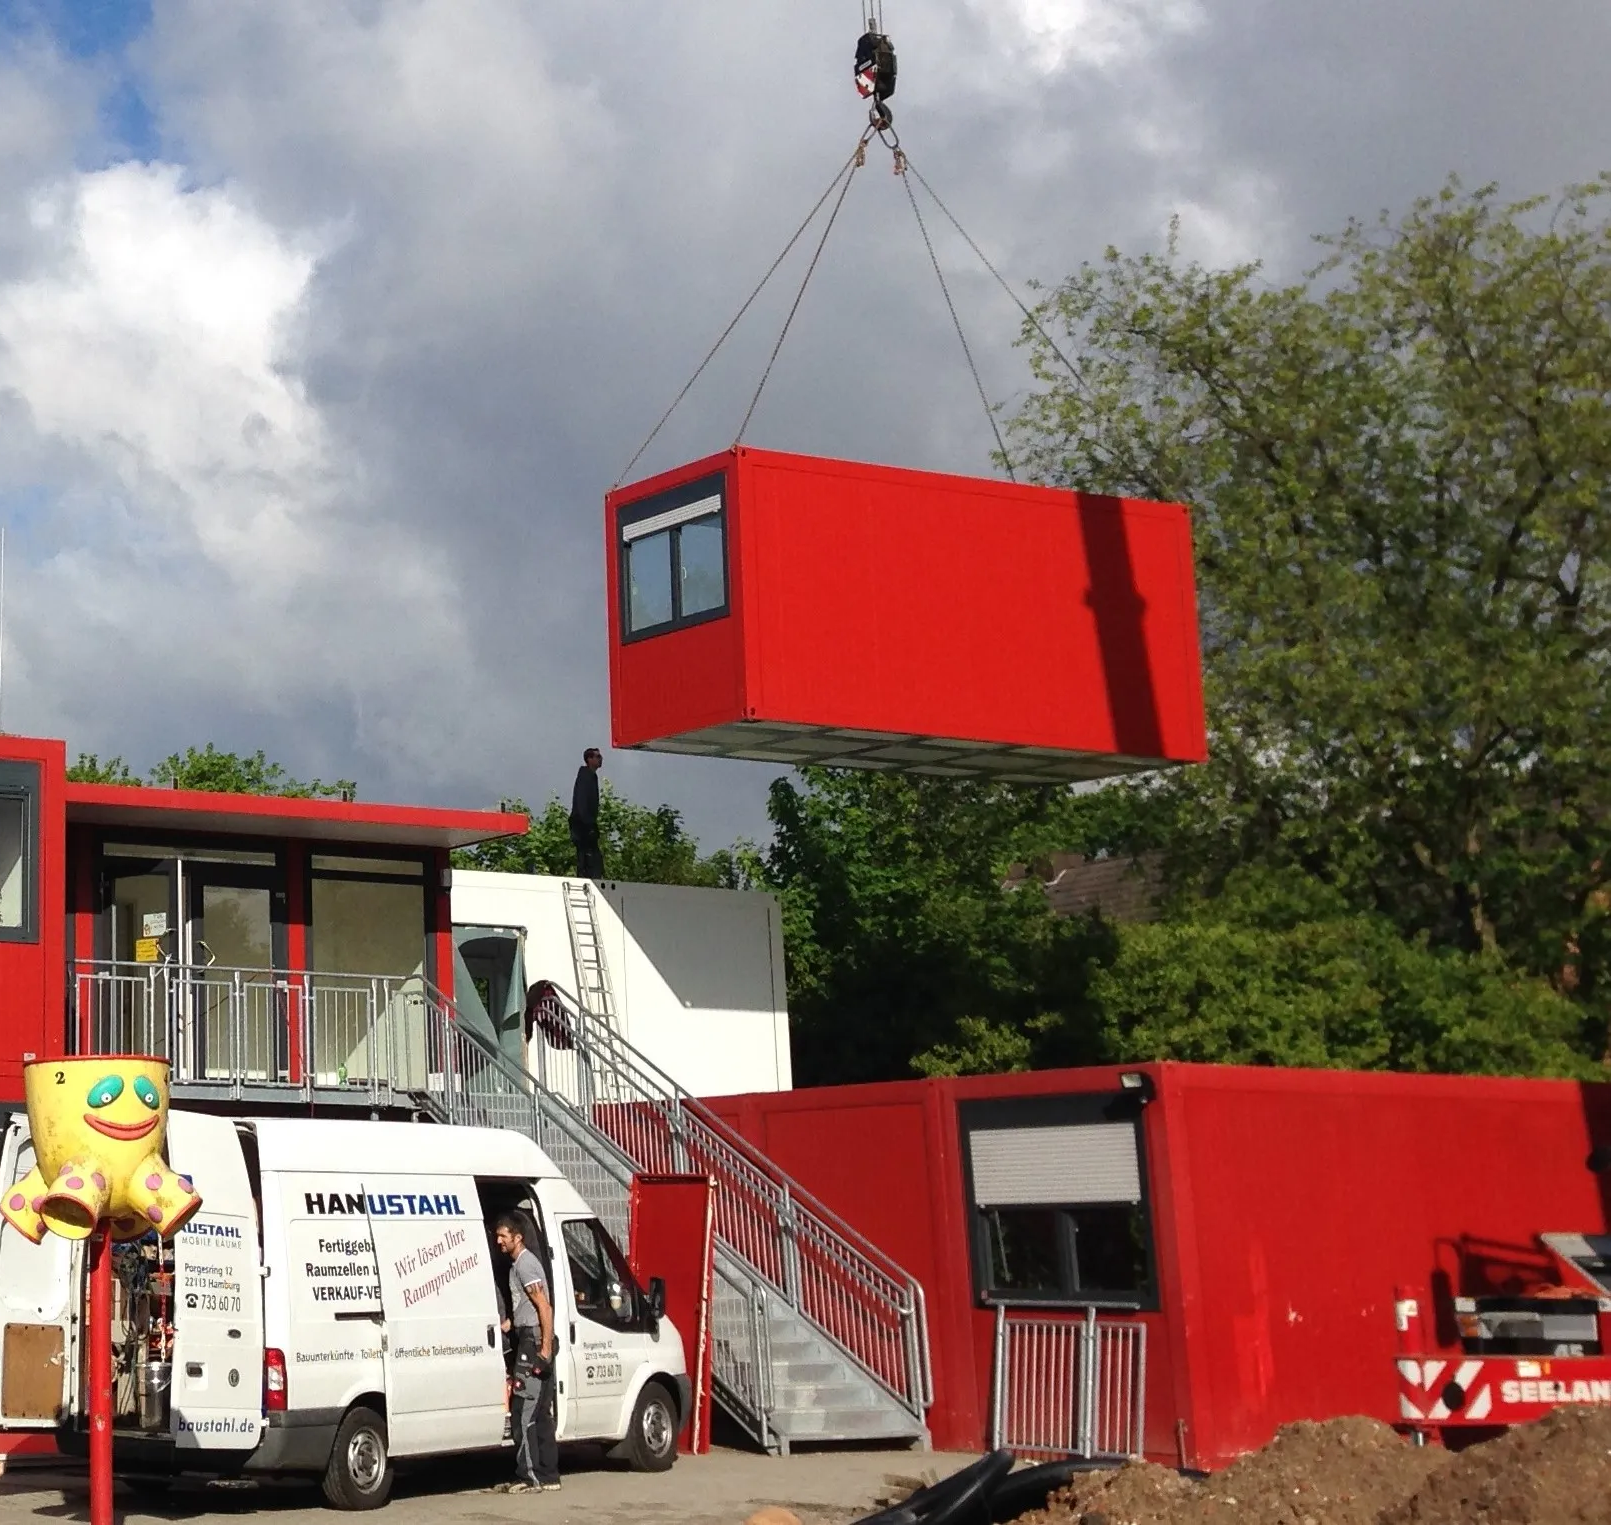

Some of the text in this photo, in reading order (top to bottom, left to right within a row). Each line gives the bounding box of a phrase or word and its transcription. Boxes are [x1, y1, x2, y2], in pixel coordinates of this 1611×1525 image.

[55, 1071, 66, 1085] 2
[182, 1236, 212, 1247] MOBILE
[394, 1229, 466, 1279] Wir lösen Ihre
[225, 1266, 233, 1276] 12
[306, 1263, 370, 1277] Raumzellen
[185, 1277, 241, 1293] 22113 Hamburg
[403, 1252, 479, 1308] Raumprobleme
[312, 1286, 381, 1301] VERKAUF-VE
[201, 1294, 241, 1312] 733 60 70
[296, 1349, 354, 1362] Bauunterkünfte
[394, 1346, 431, 1358] öffentliche
[1502, 1380, 1611, 1403] SEELAN
[178, 1416, 255, 1433] baustahl.de
